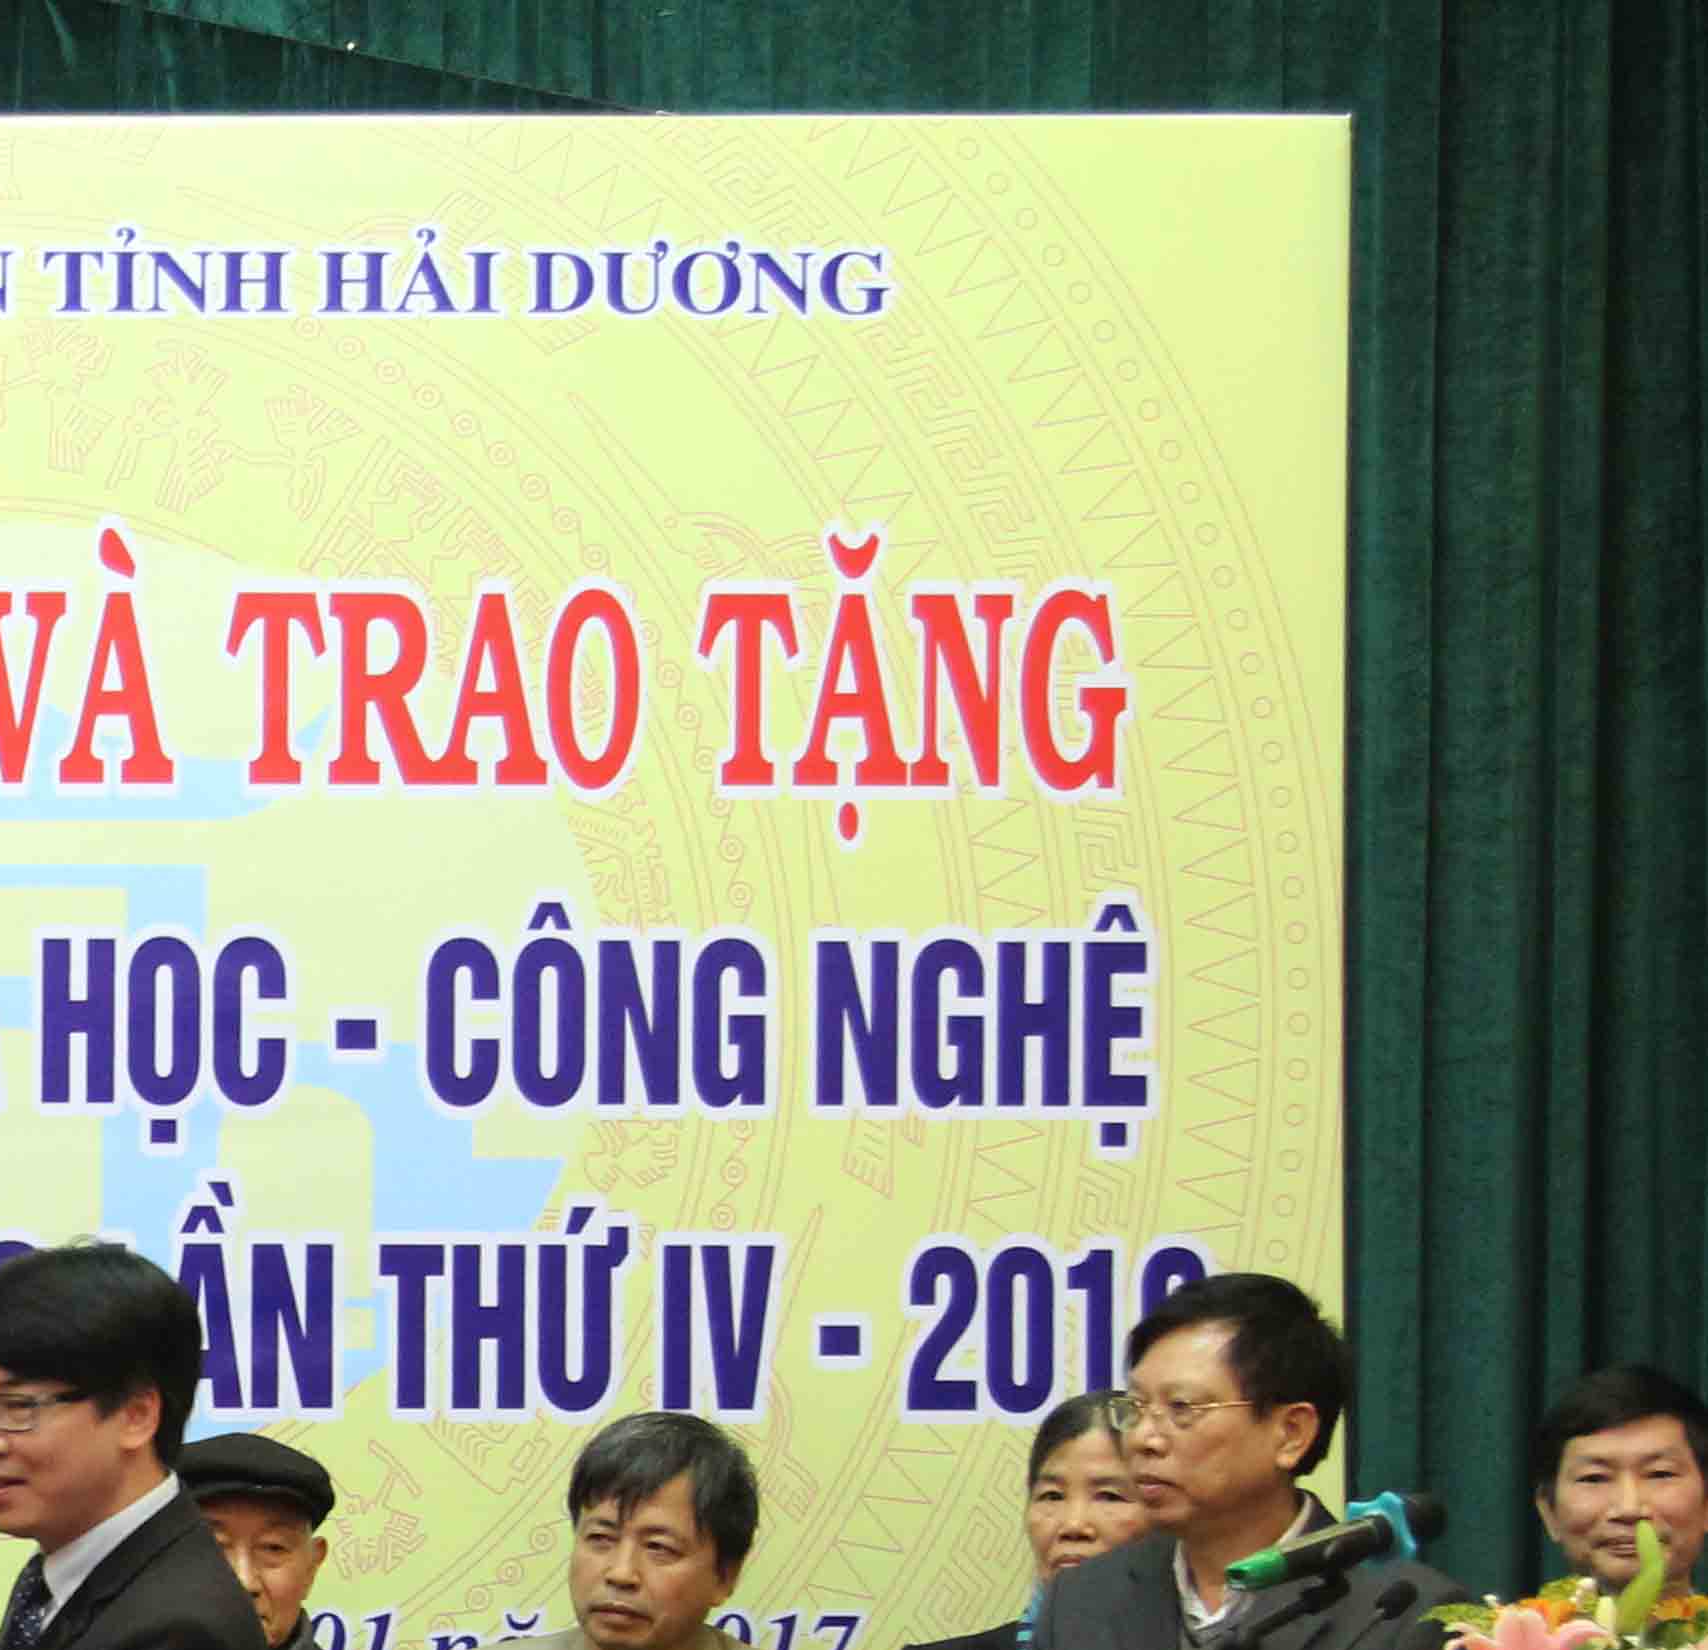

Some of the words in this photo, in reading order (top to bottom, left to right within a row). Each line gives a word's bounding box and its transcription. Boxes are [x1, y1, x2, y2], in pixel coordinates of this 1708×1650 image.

[45, 230, 282, 311] TỈNH
[325, 230, 493, 312] HẢI
[534, 241, 884, 313] DƯƠNG
[227, 589, 639, 789] TRAO
[700, 536, 1126, 839] TẶNG
[41, 936, 286, 1144] HỌC
[426, 902, 765, 1108] CÔNG
[816, 904, 1145, 1147] NGHỆ
[144, 1182, 334, 1409] ẦN
[379, 1206, 629, 1412] THỨ
[662, 1245, 773, 1410] IV
